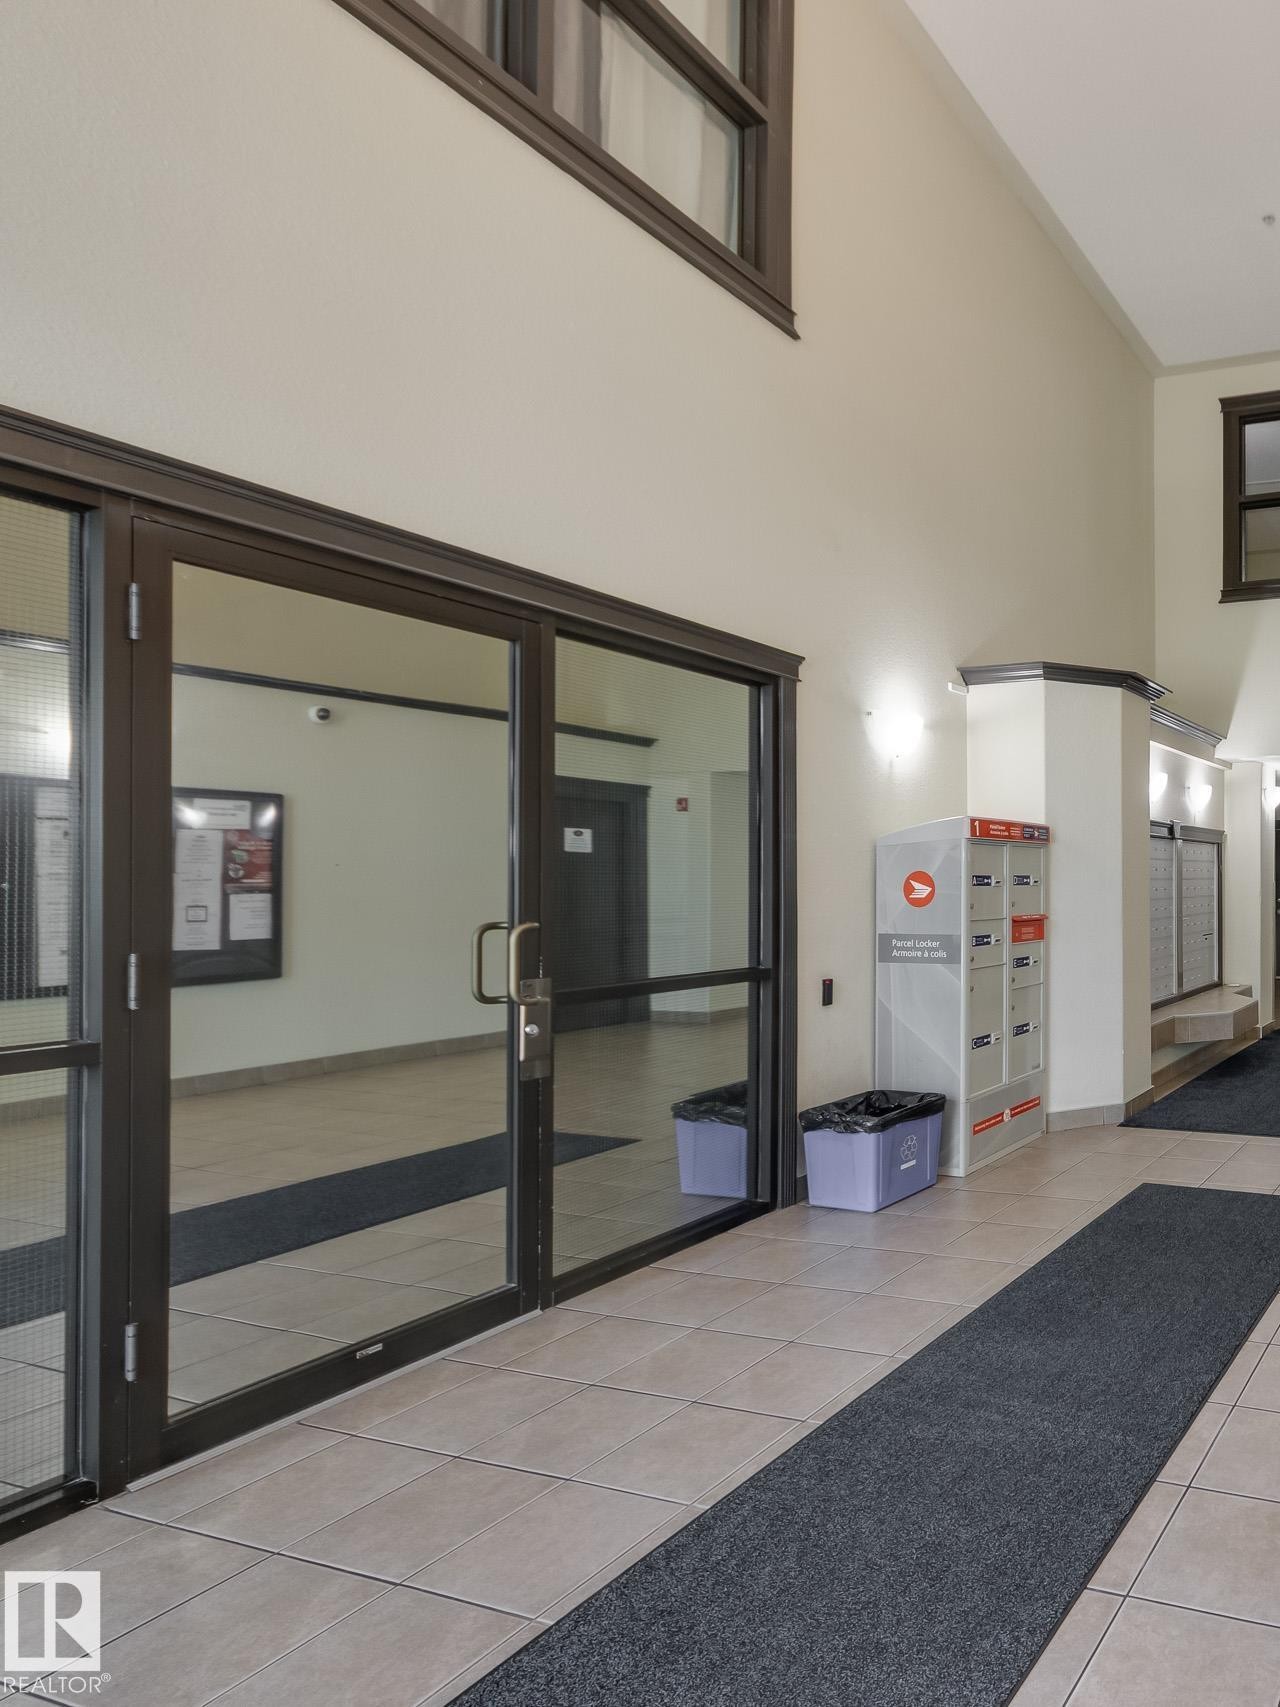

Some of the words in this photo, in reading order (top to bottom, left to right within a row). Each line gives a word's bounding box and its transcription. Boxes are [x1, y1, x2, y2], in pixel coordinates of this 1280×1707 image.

[974, 820, 980, 836] 1
[891, 938, 914, 947] Parcel
[915, 939, 940, 948] Locker
[891, 949, 922, 957] Armoire
[923, 949, 928, 958] à
[930, 950, 947, 958] colis
